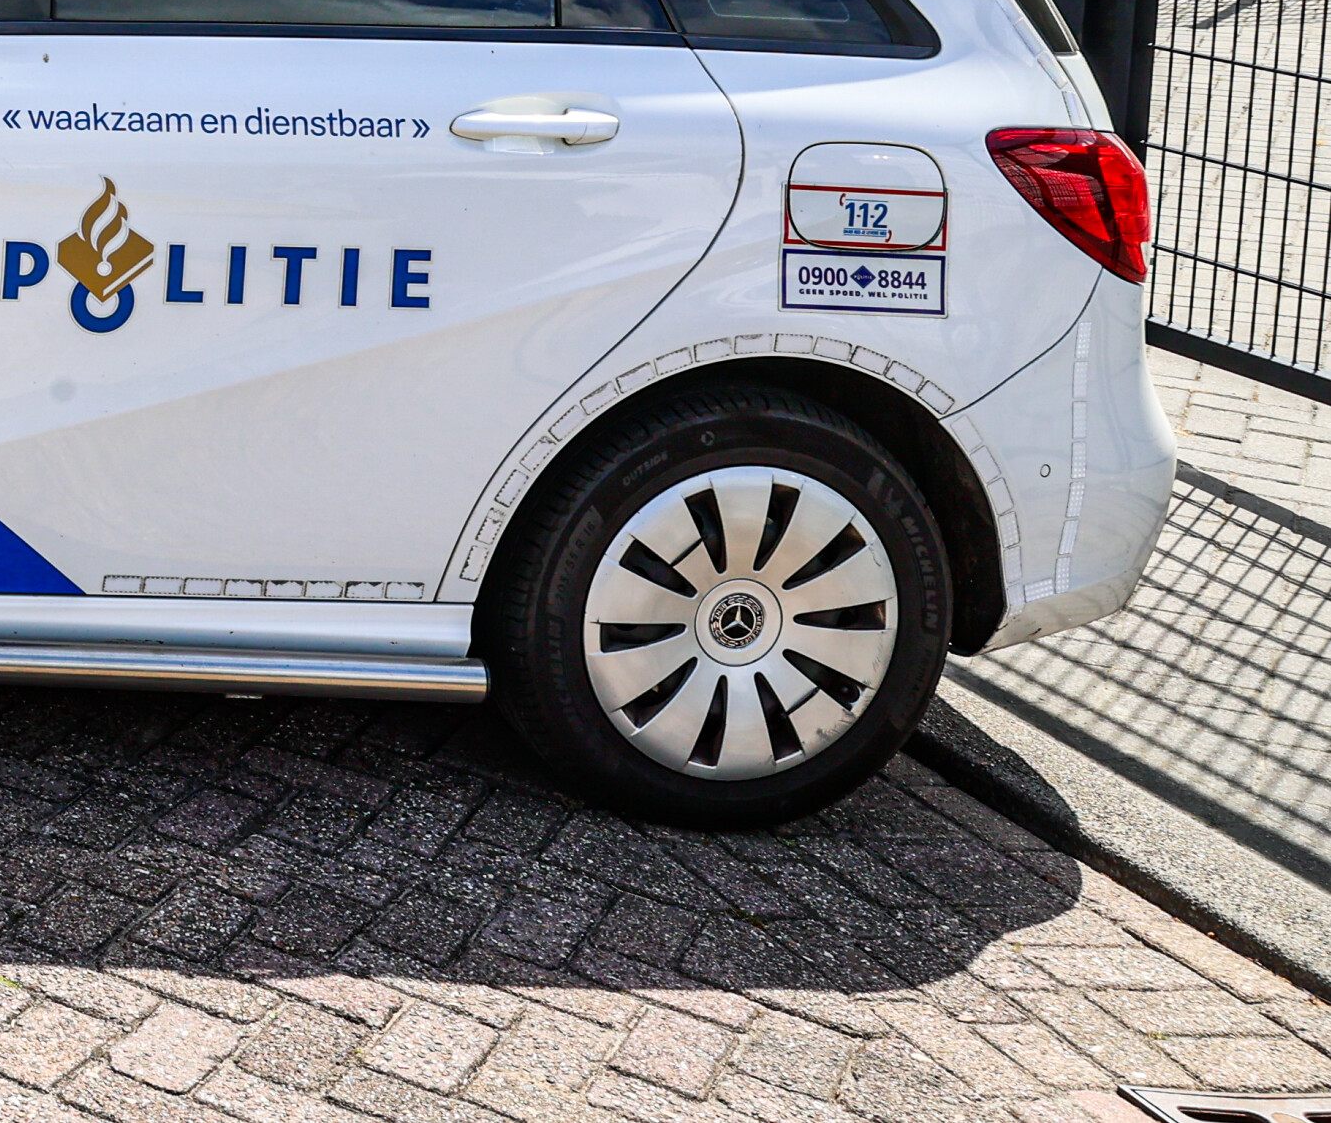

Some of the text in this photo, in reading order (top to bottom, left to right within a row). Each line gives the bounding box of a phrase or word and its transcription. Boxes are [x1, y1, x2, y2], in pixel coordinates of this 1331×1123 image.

[27, 102, 194, 133] waakzaam
[200, 113, 238, 135] en
[244, 106, 406, 139] dienstbaar
[1, 231, 434, 334] POLITIE
[798, 266, 848, 287] 0900
[877, 269, 927, 290] 8844
[829, 289, 864, 298] SPOED,
[891, 292, 928, 300] POLITIE
[900, 514, 938, 628] MICHELIN
